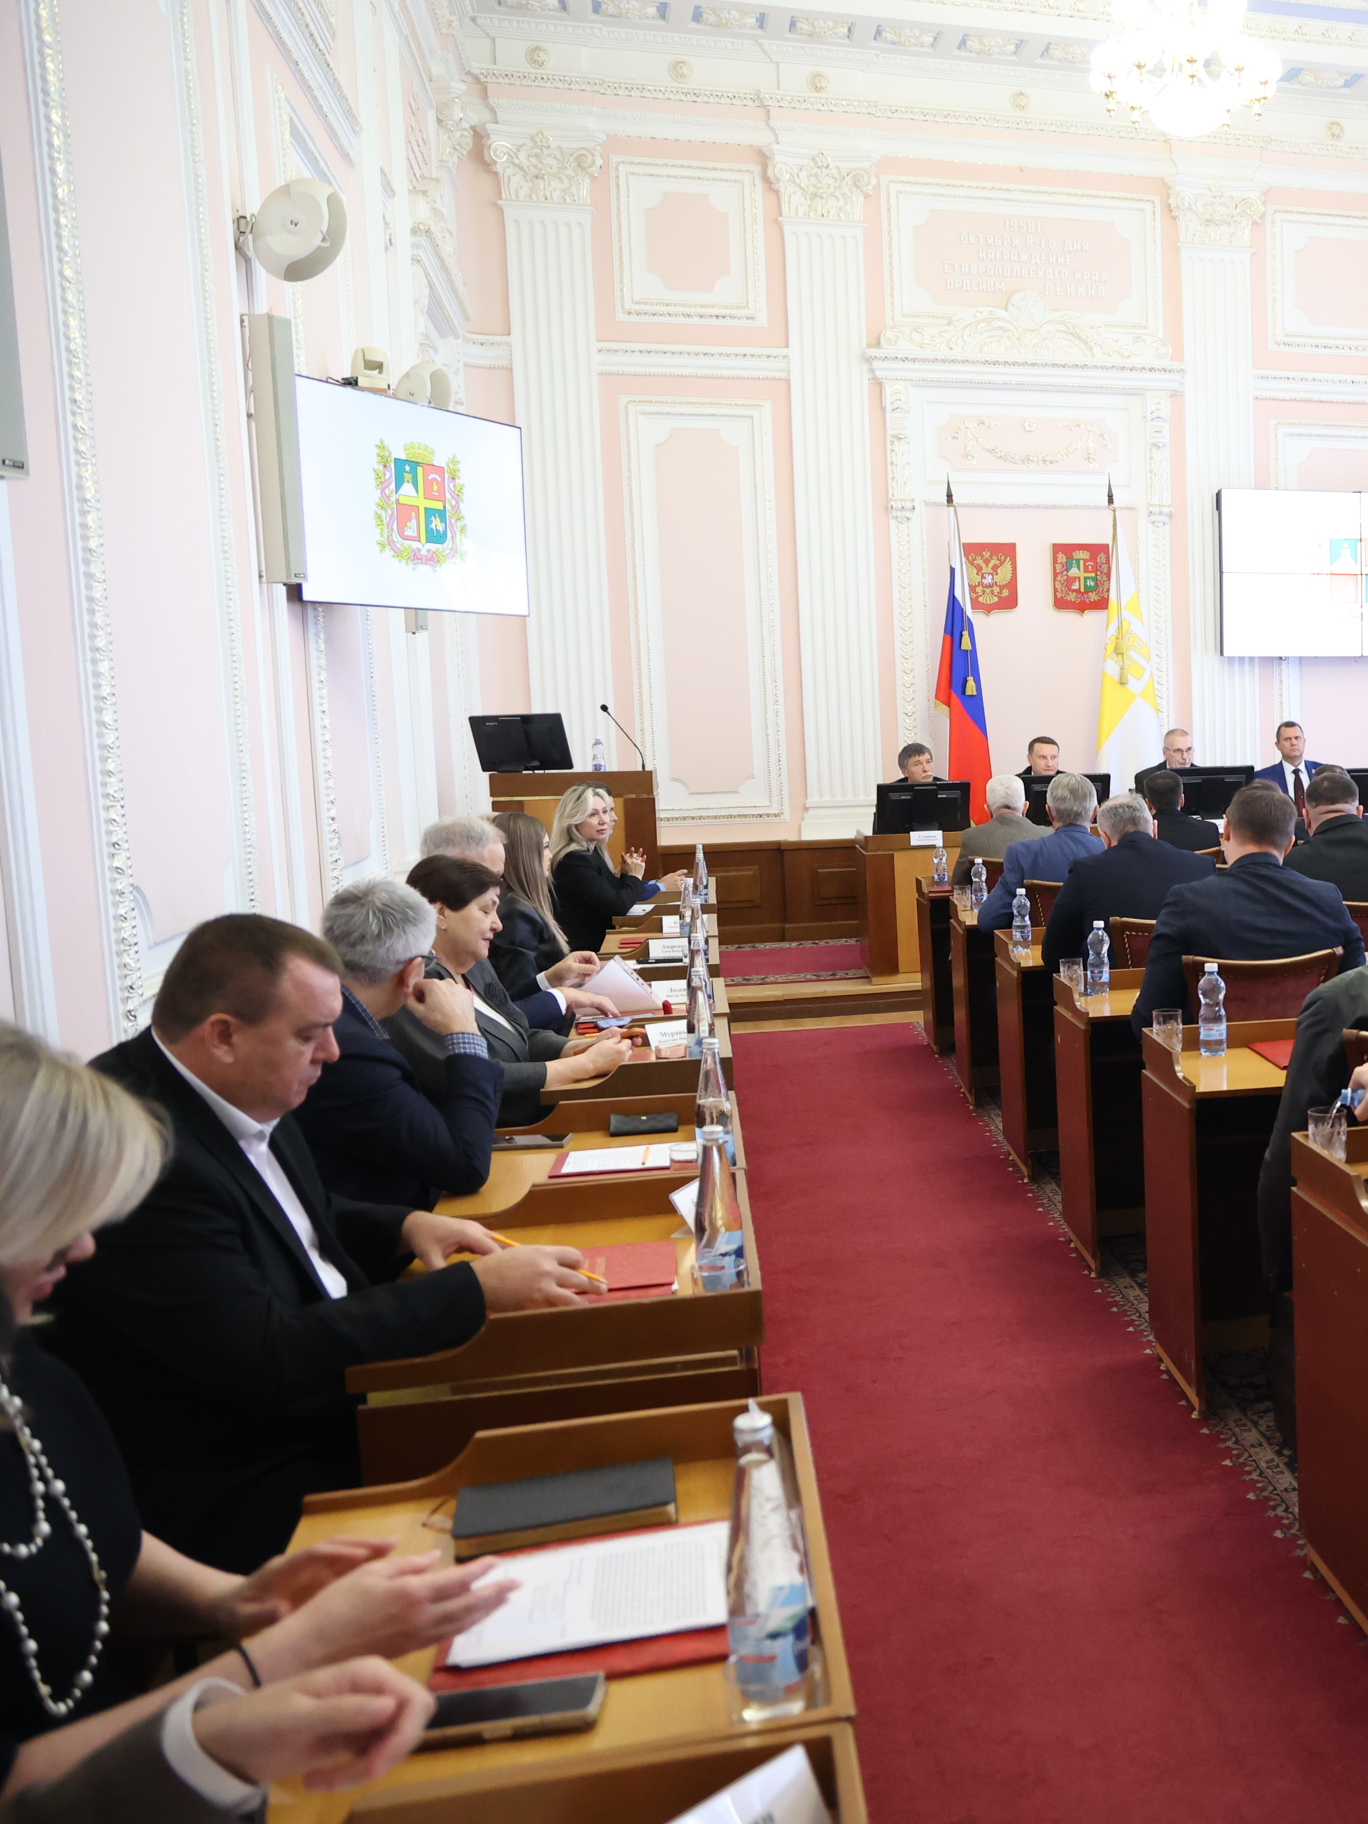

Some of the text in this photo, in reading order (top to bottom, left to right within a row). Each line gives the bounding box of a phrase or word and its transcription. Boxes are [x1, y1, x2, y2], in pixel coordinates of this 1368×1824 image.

[960, 233, 1019, 247] ОКТЯБРЯ
[1063, 240, 1090, 252] ДНЯ
[978, 249, 1073, 265] НАГРАЖДЕНИЕ
[943, 260, 1108, 283] СТАВРОПОЛЬСКОГО КРАЯ
[946, 279, 1105, 298] ОРДЕНОМ ЛЕНИНА
